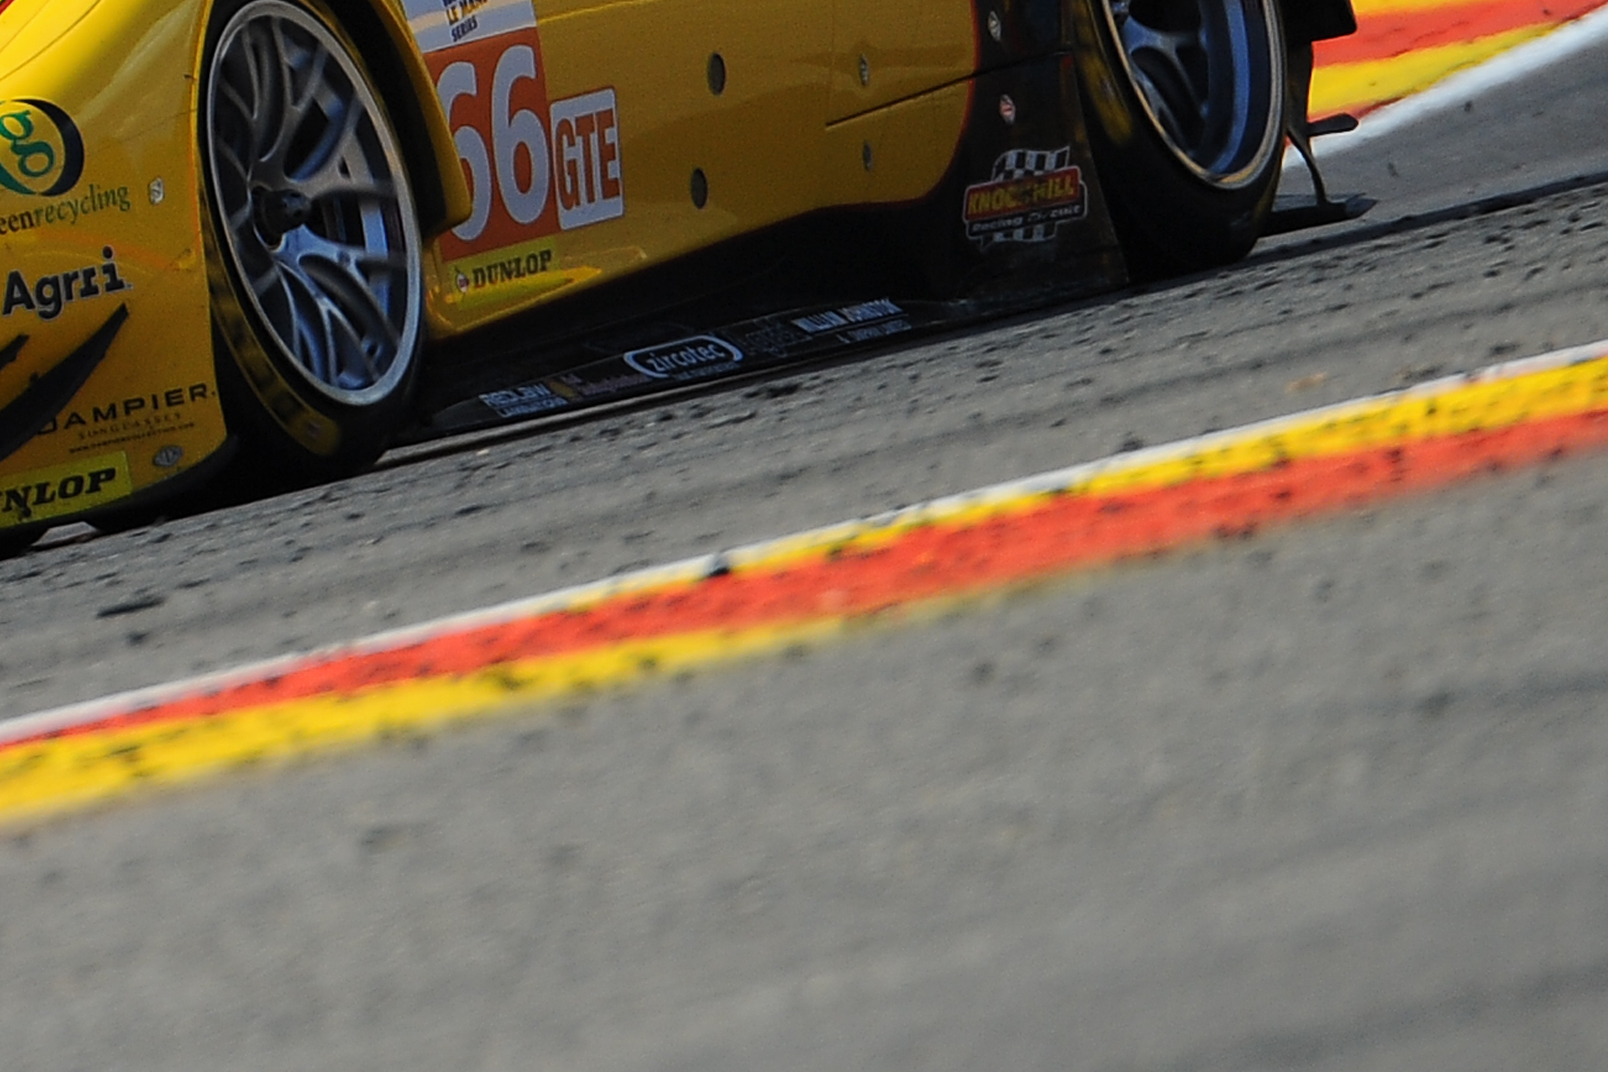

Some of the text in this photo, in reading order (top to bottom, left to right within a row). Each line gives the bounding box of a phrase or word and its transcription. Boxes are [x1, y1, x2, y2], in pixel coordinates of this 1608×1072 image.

[446, 5, 459, 26] LE
[451, 15, 478, 43] SERIES
[437, 44, 551, 241] 66
[555, 108, 621, 211] GTE
[473, 249, 552, 289] DUNLOP
[646, 344, 725, 372] zircotec
